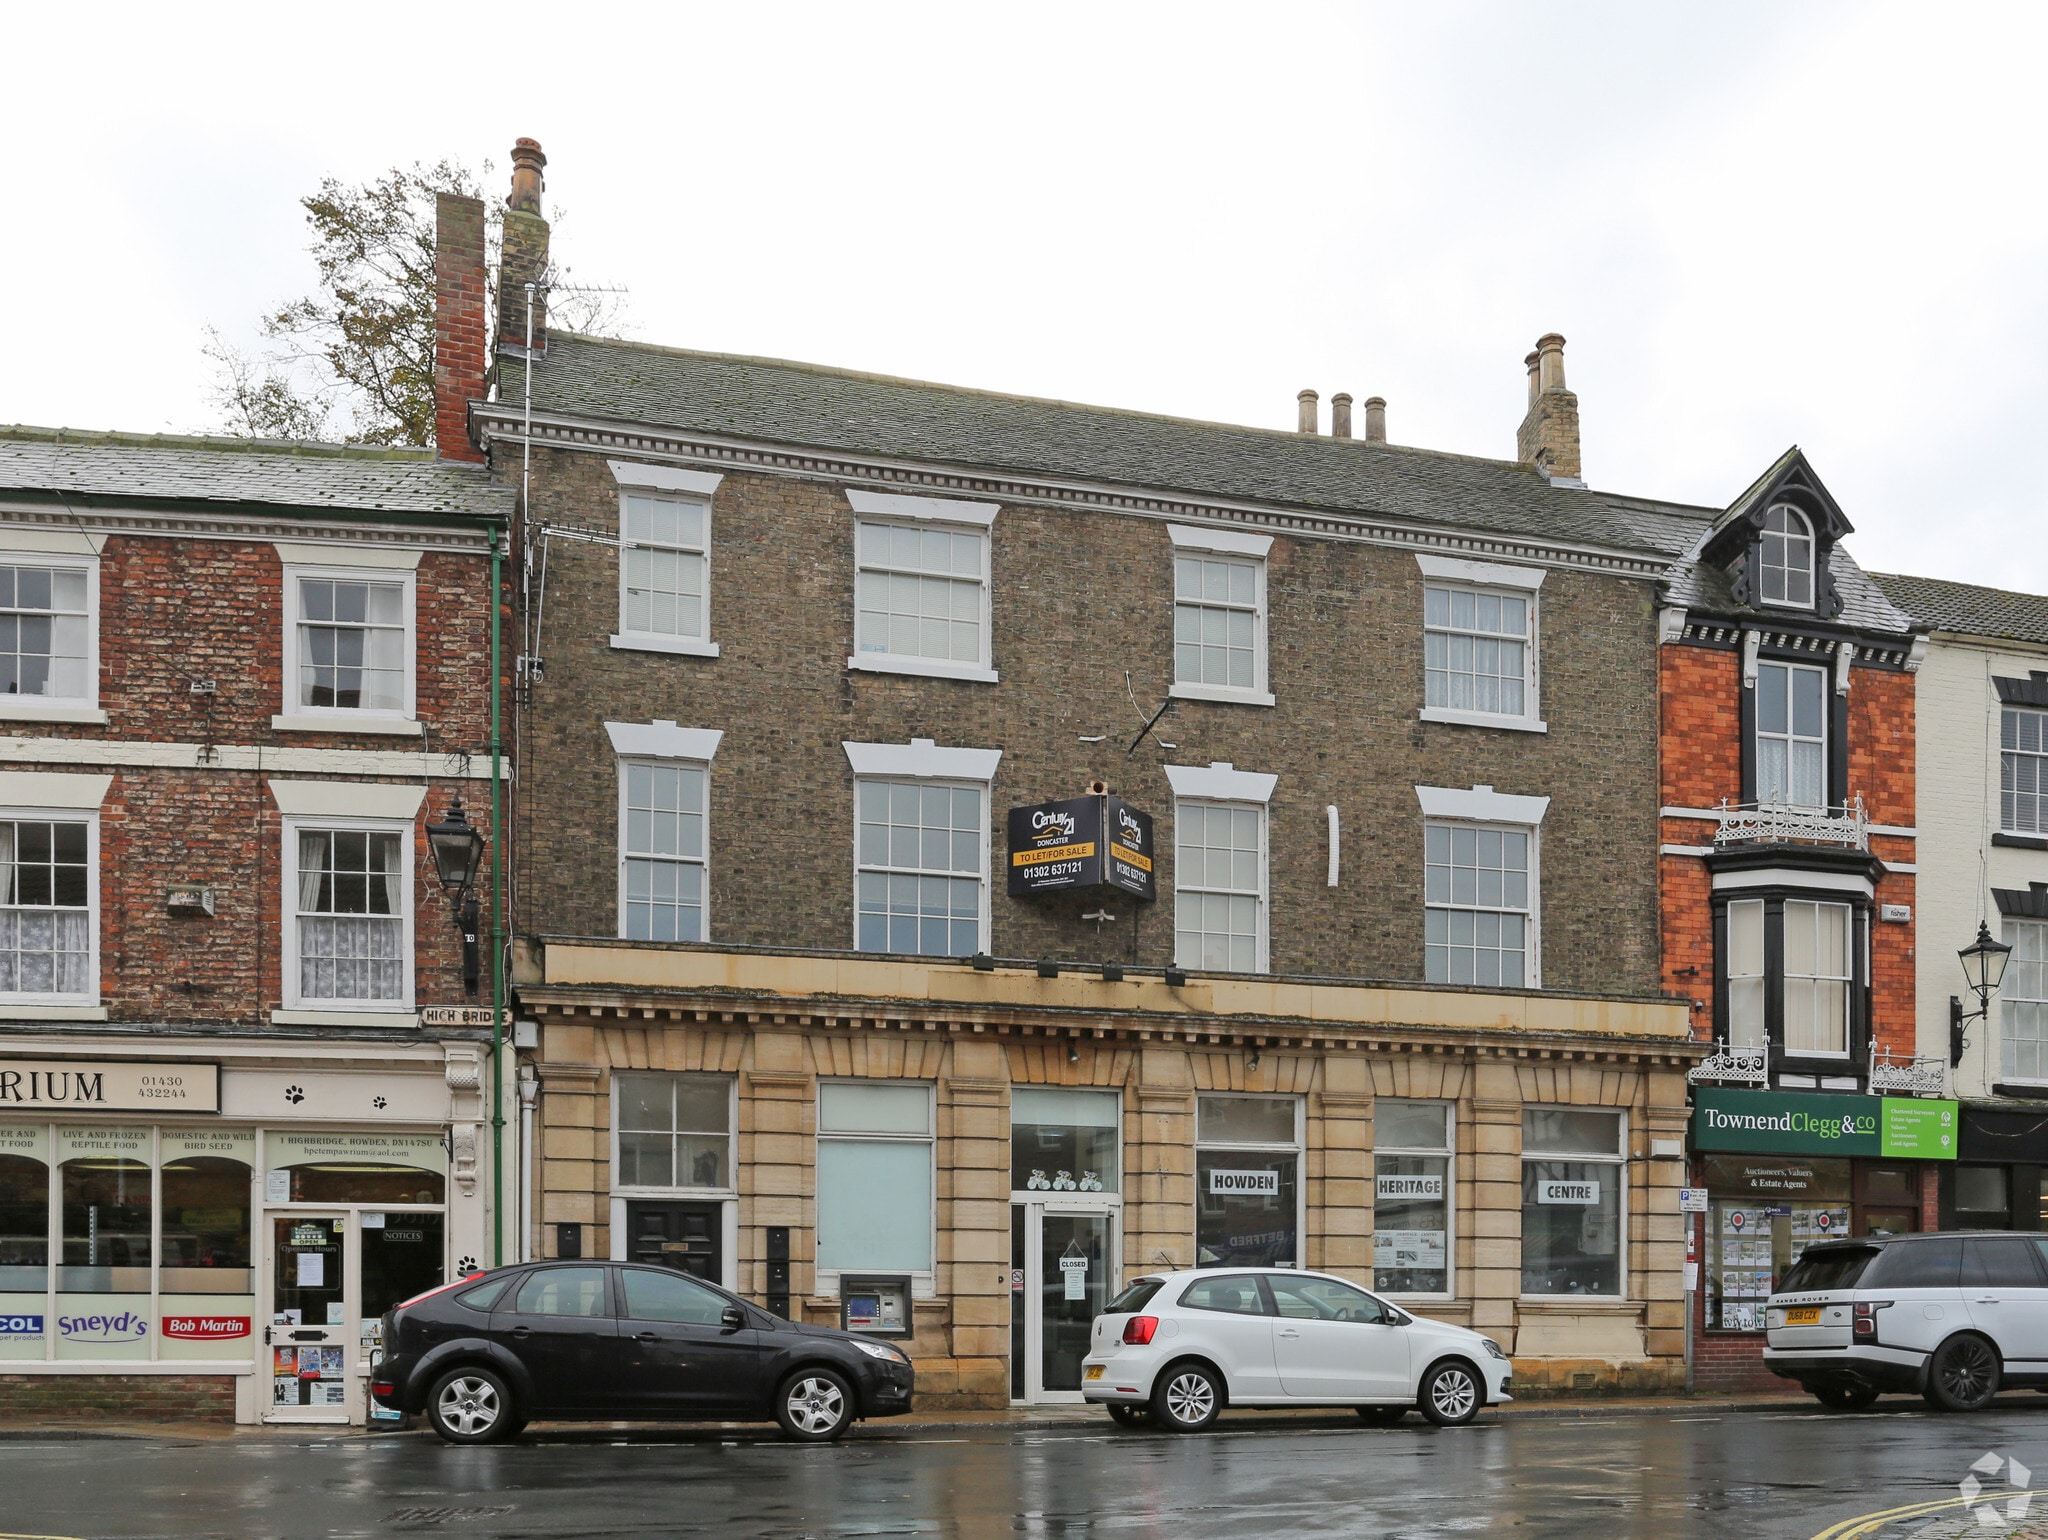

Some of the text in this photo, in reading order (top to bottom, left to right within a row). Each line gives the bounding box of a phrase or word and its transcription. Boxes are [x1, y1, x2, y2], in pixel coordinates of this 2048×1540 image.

[1031, 811, 1075, 835] Century 21
[1037, 837, 1069, 847] DONCASTER
[1020, 854, 1031, 862] TO
[1066, 846, 1087, 856] SALE
[1137, 857, 1148, 868] SALE
[1023, 861, 1082, 879] 01302 637121
[462, 1011, 508, 1023] BRIDE
[141, 1076, 183, 1086] 01430
[0, 1071, 107, 1103] RIUM
[138, 1088, 187, 1098] 432244
[16, 1130, 36, 1138] AND
[87, 1131, 107, 1139] AND
[162, 1132, 208, 1140] DOMESTIC
[9, 1140, 34, 1148] FOOD
[71, 1141, 110, 1149] REPTILE
[288, 1138, 347, 1146] HIGHBRIDGE,
[349, 1138, 390, 1146] HOWDEN,
[1744, 1167, 1813, 1177] Auctioneers, Valuers
[1214, 1174, 1274, 1189] HOWDEN
[1750, 1179, 1807, 1190] & Estate Agents
[1379, 1180, 1441, 1194] HERITAGE
[1546, 1185, 1591, 1198] CENTRE
[385, 1231, 421, 1239] NOTICES
[281, 1245, 312, 1253] Opening
[58, 1312, 147, 1335] Sneyd's
[169, 1319, 244, 1332] Bob Martin
[14, 1334, 45, 1342] products
